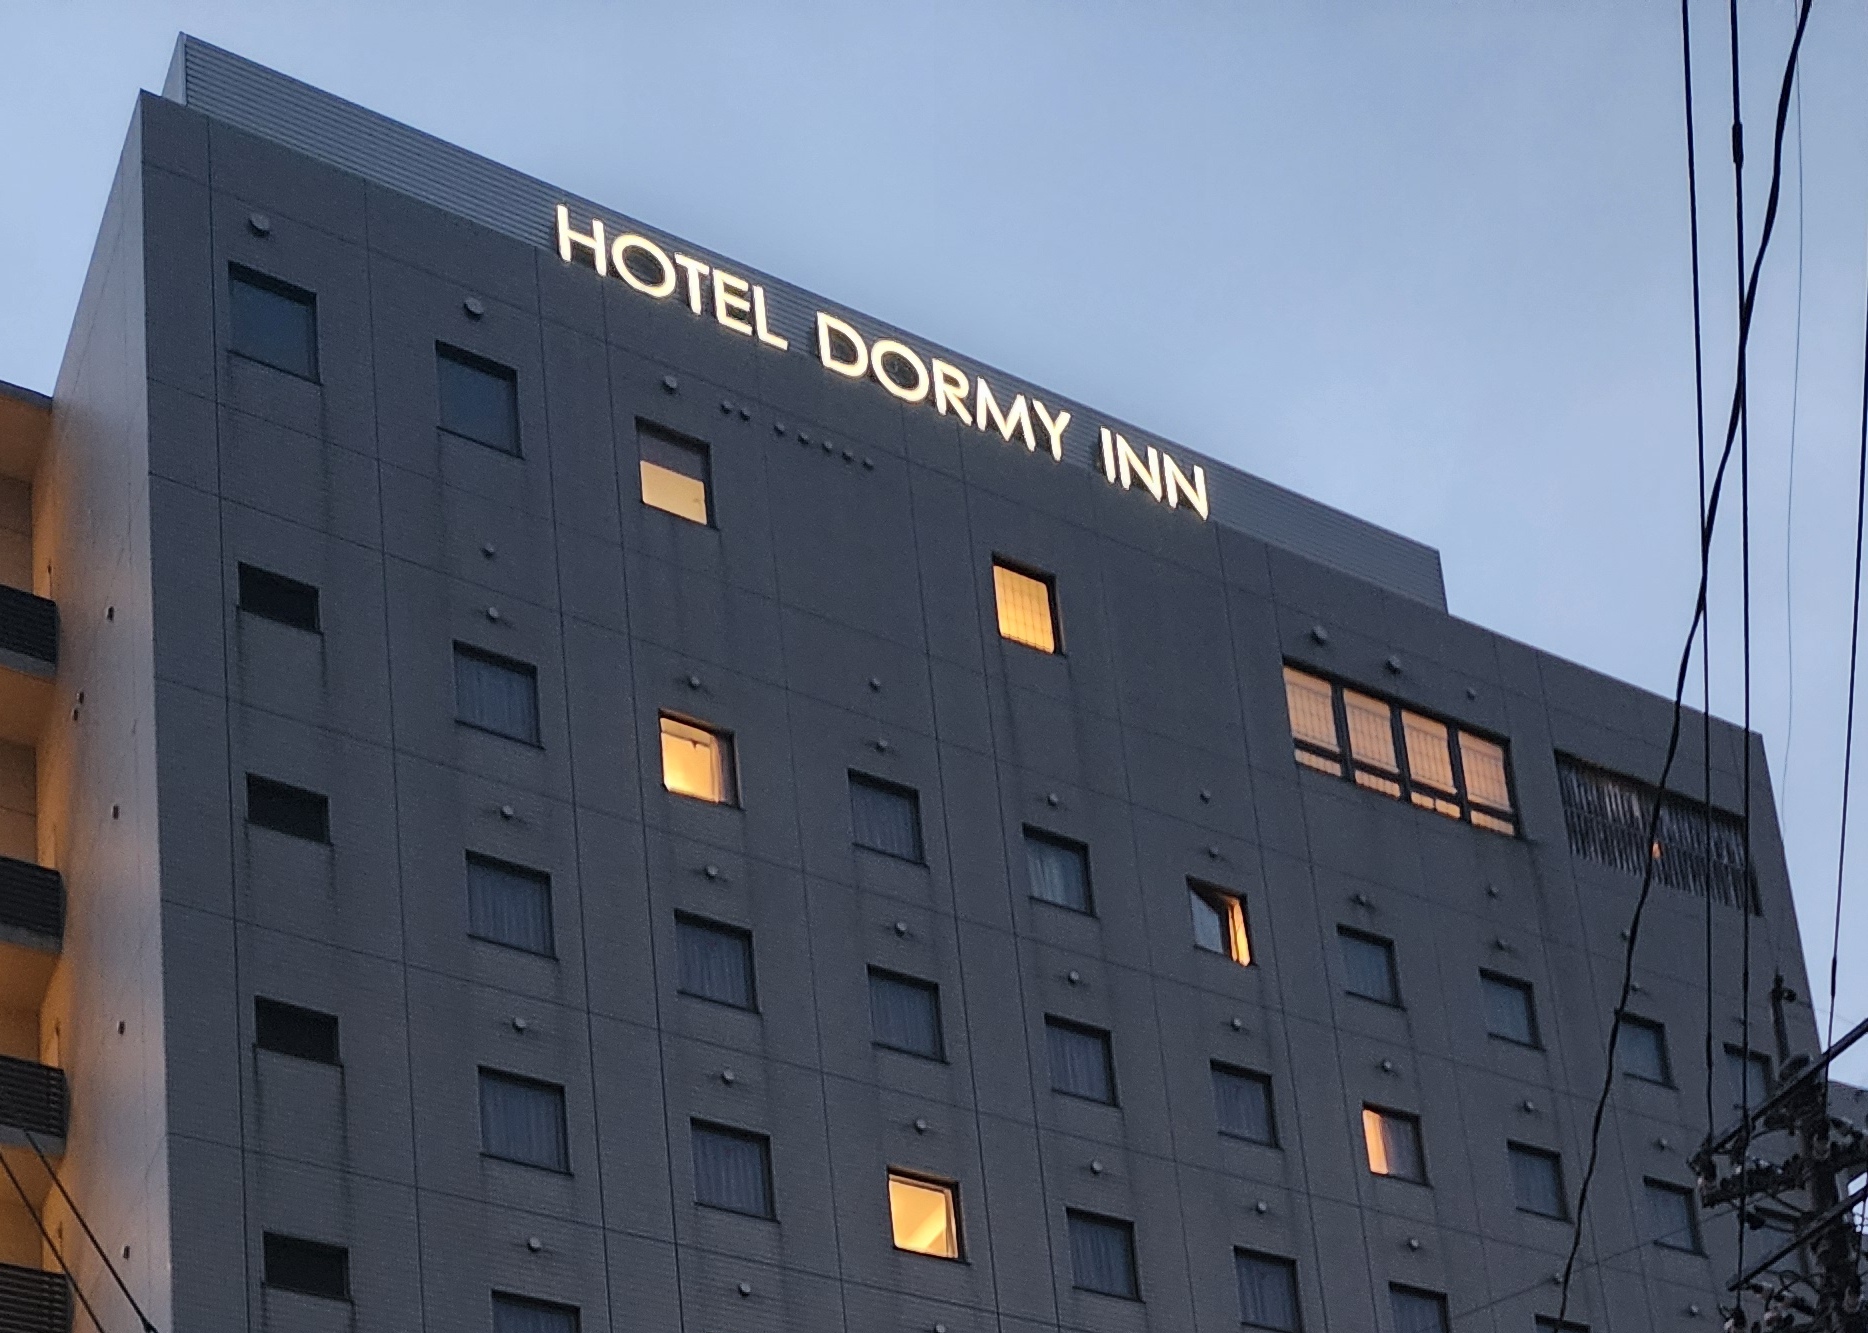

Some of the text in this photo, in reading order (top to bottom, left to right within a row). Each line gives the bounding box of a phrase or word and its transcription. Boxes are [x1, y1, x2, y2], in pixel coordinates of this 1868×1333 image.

[556, 204, 1209, 520] HOTEL DORMY INN
